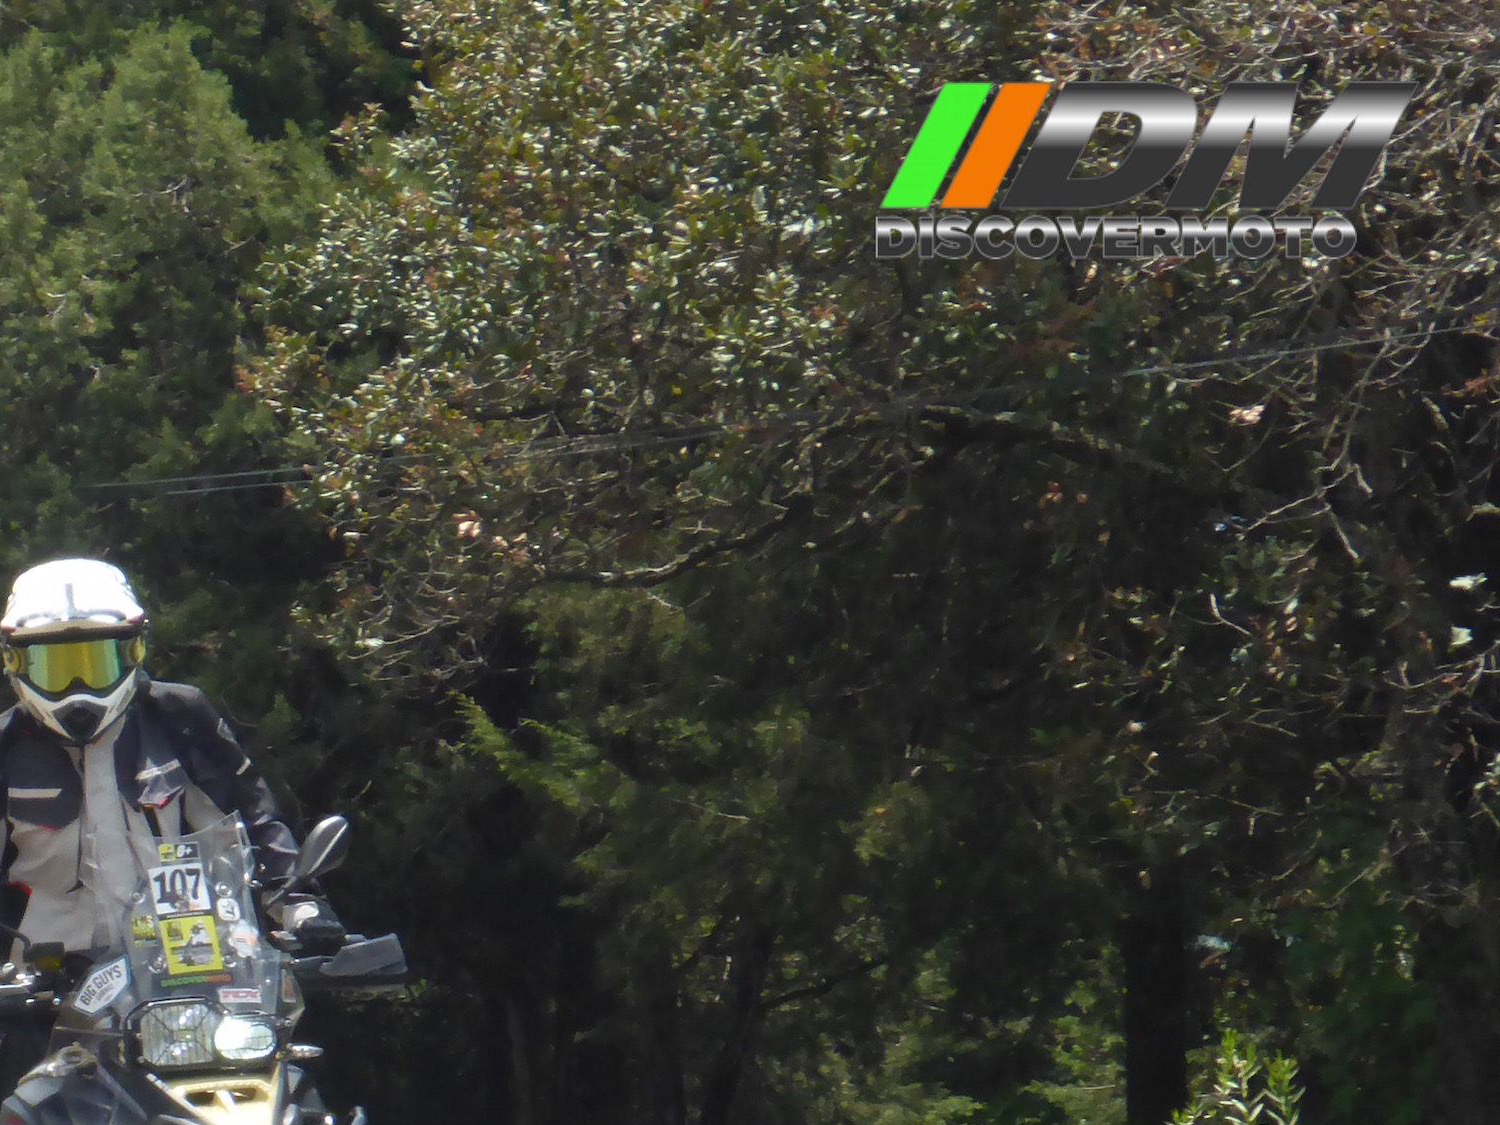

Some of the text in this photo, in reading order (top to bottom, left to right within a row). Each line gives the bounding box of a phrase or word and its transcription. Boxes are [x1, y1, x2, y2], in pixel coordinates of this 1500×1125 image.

[153, 868, 202, 906] 107
[79, 984, 97, 1006] BIG
[93, 964, 122, 989] GUYS
